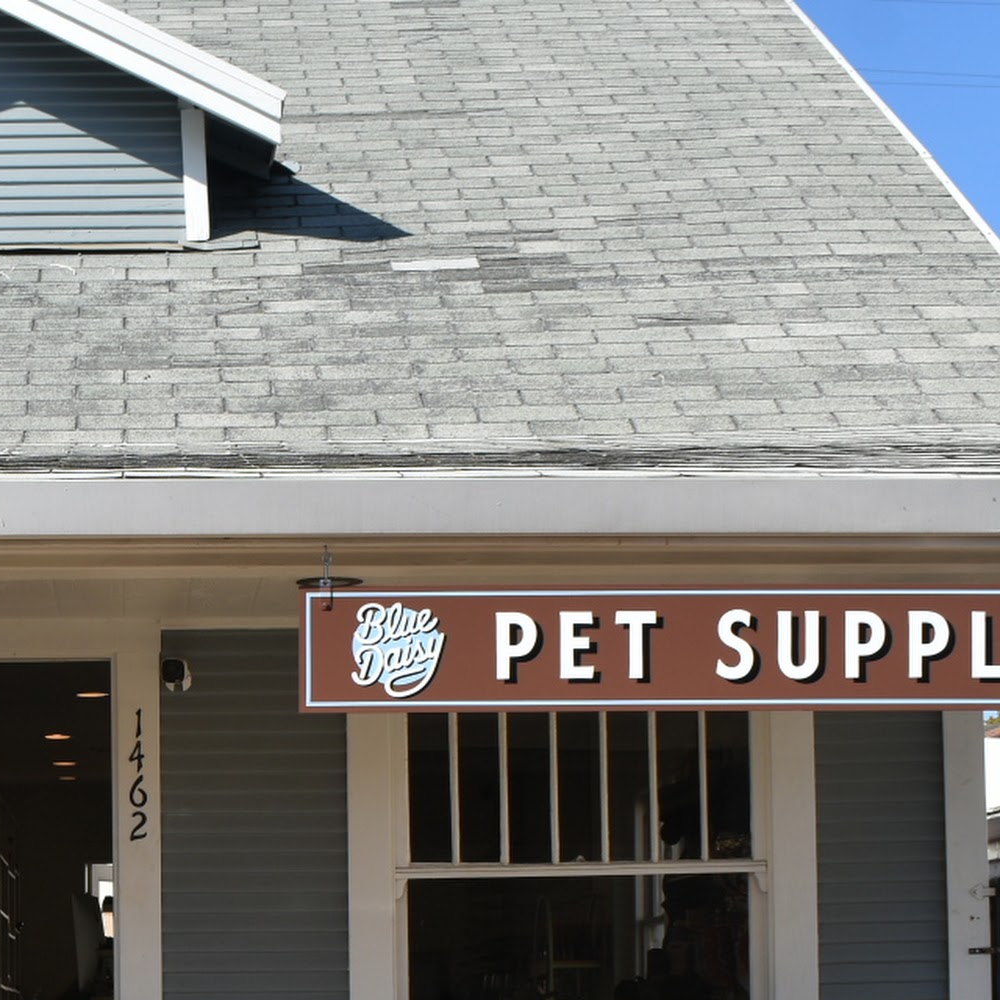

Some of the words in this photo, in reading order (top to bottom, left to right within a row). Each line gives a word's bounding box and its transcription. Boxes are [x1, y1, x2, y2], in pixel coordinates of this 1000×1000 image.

[353, 602, 439, 645] Blue
[495, 609, 661, 682] PET
[716, 608, 1000, 682] SUPPL
[351, 632, 446, 698] Daisy
[128, 708, 148, 842] 1462
